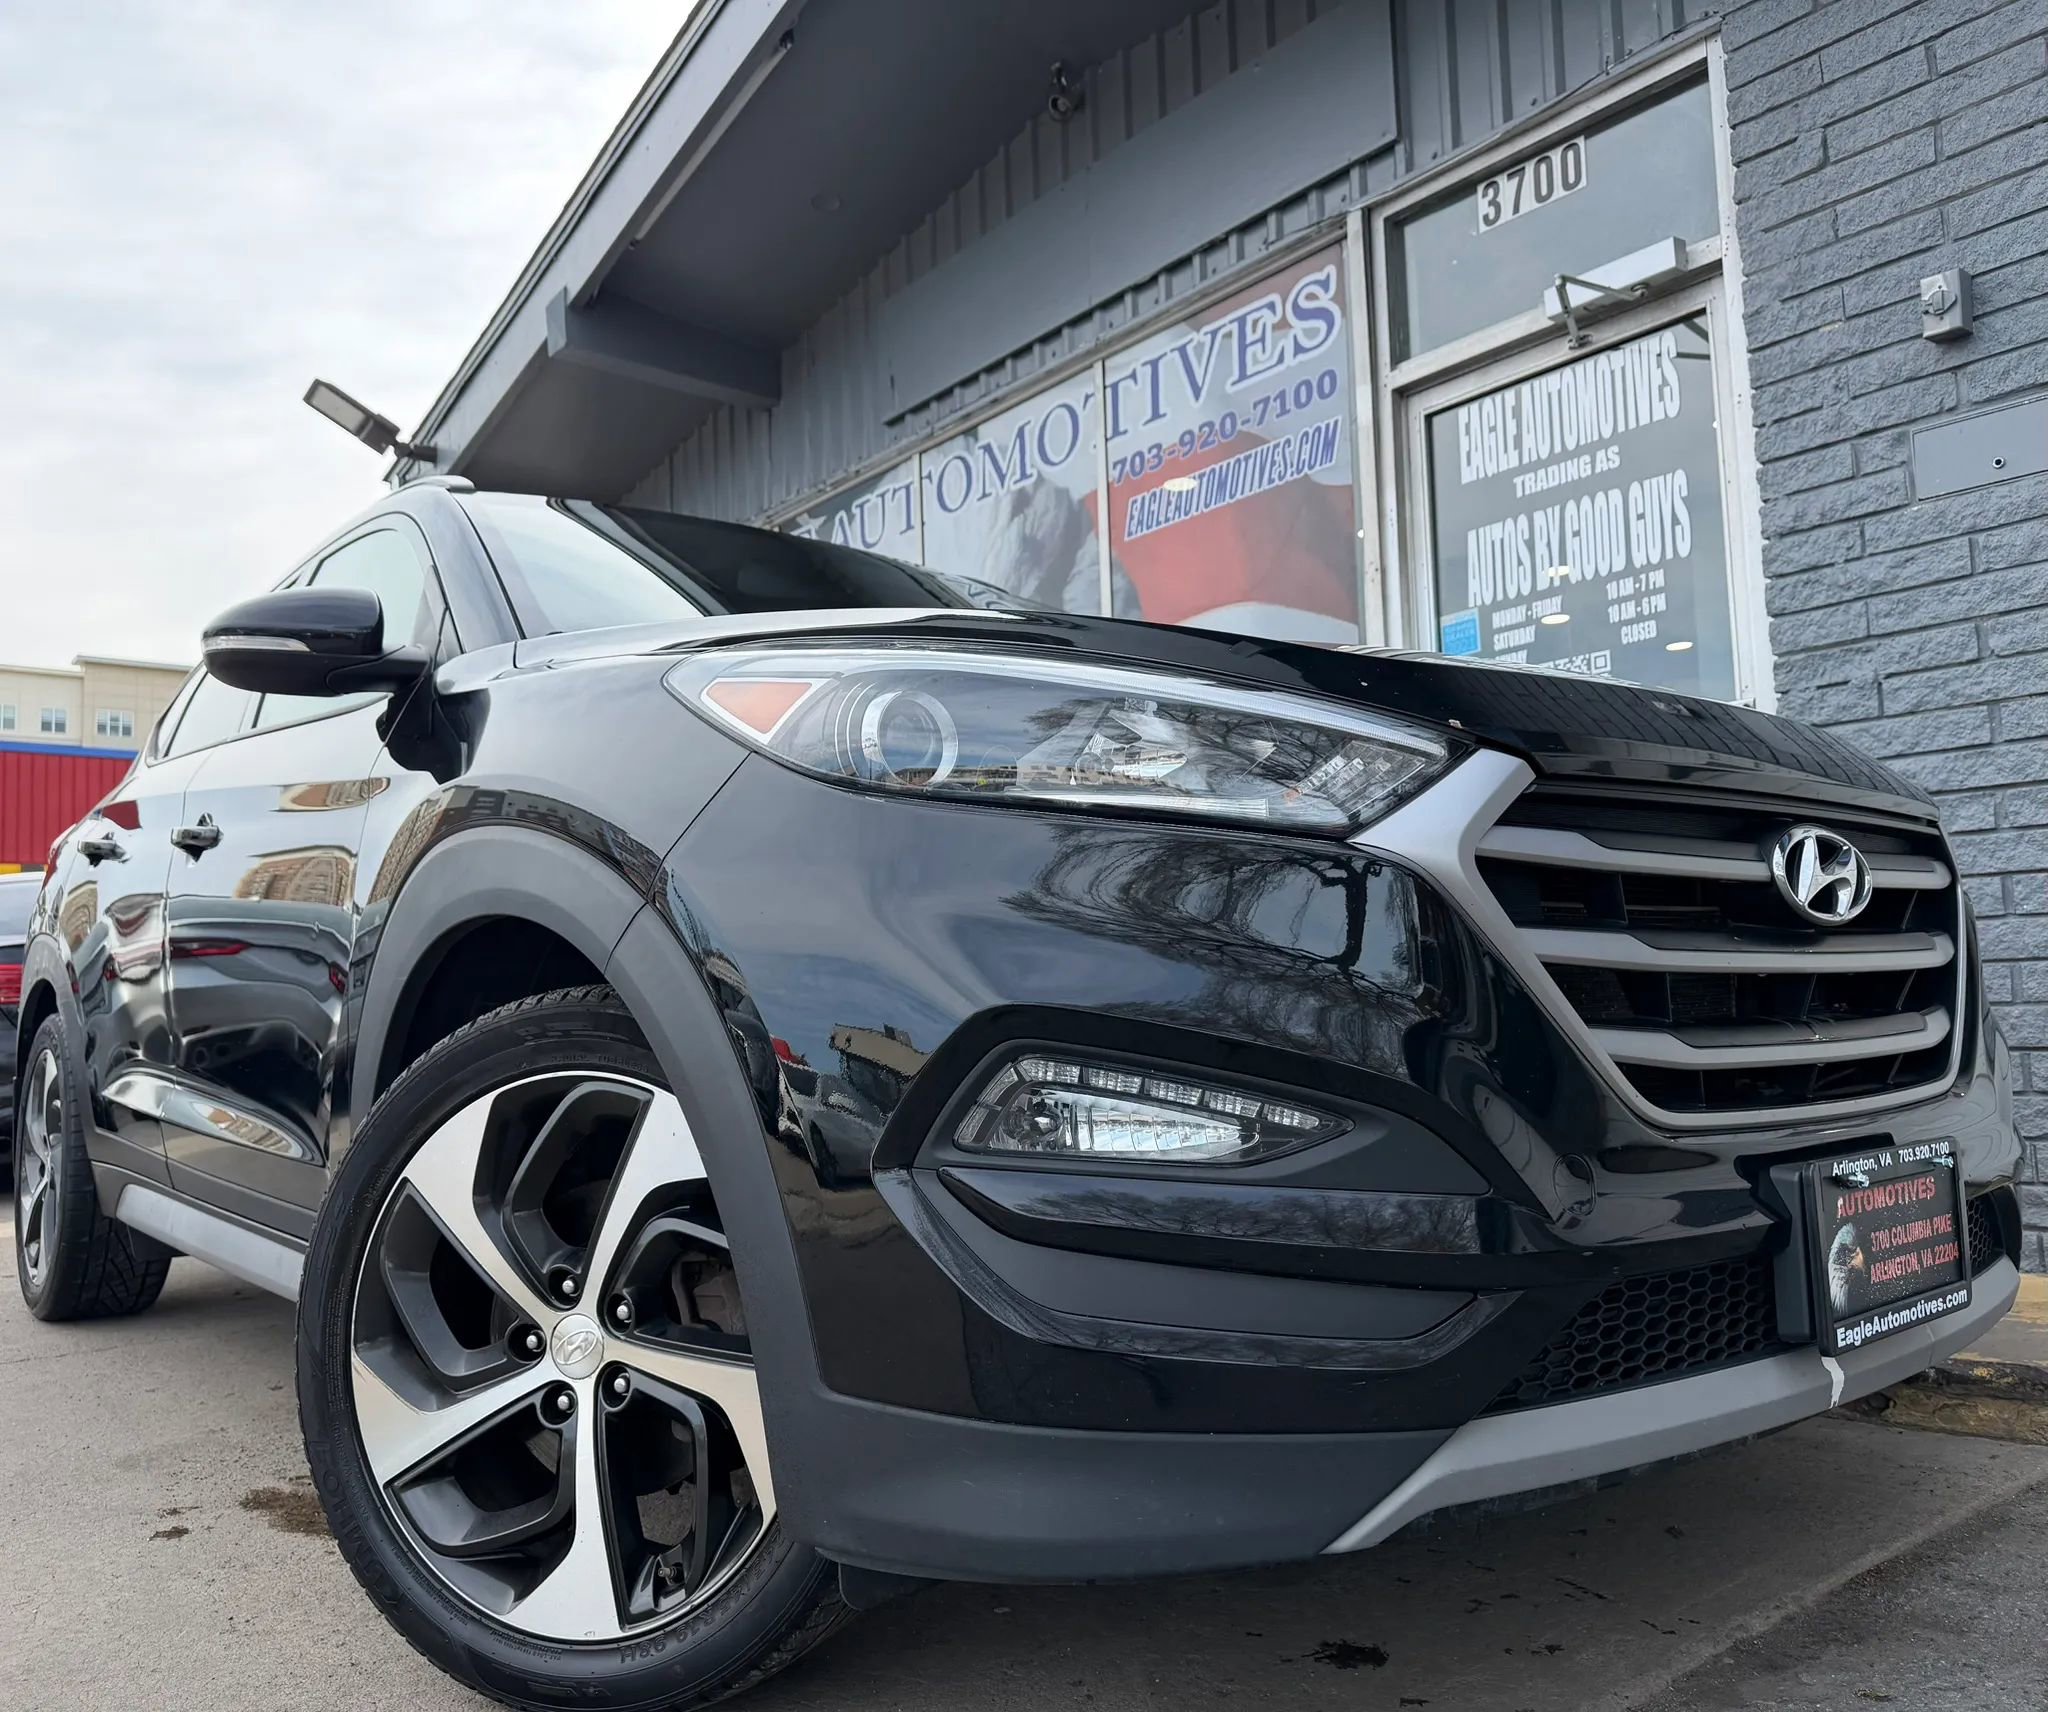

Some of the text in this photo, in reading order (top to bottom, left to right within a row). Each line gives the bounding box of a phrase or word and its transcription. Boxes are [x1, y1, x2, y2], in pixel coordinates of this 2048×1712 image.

[1482, 142, 1583, 228] 3700
[1112, 368, 1338, 485] 703-920-7100
[1458, 331, 1680, 484] EAGLE AUTOMOTIVES
[1125, 418, 1340, 540] EAGLEAUTOMOTIVES.COM
[1513, 445, 1621, 498] TRADING AS
[1467, 468, 1692, 608] AUTOS BY GOOD GUYS
[1606, 581, 1618, 600] 10
[1648, 568, 1665, 590] PM
[1492, 595, 1563, 629] MONDAY FRIDAY
[1608, 604, 1620, 624] 10
[1650, 592, 1666, 614] PM
[1494, 625, 1536, 652] SATURDAY
[1621, 620, 1657, 645] CLOSED
[1832, 1141, 1950, 1176] Arlington, VA 703.920.7100
[1837, 1175, 1936, 1218] AUTOMOTIVES
[1871, 1213, 1953, 1252] 3700 COLUMBIA PIKE
[1871, 1241, 1960, 1284] ARLINGTON, VA 22204
[1836, 1288, 1968, 1348] EagleAutomotives.com
